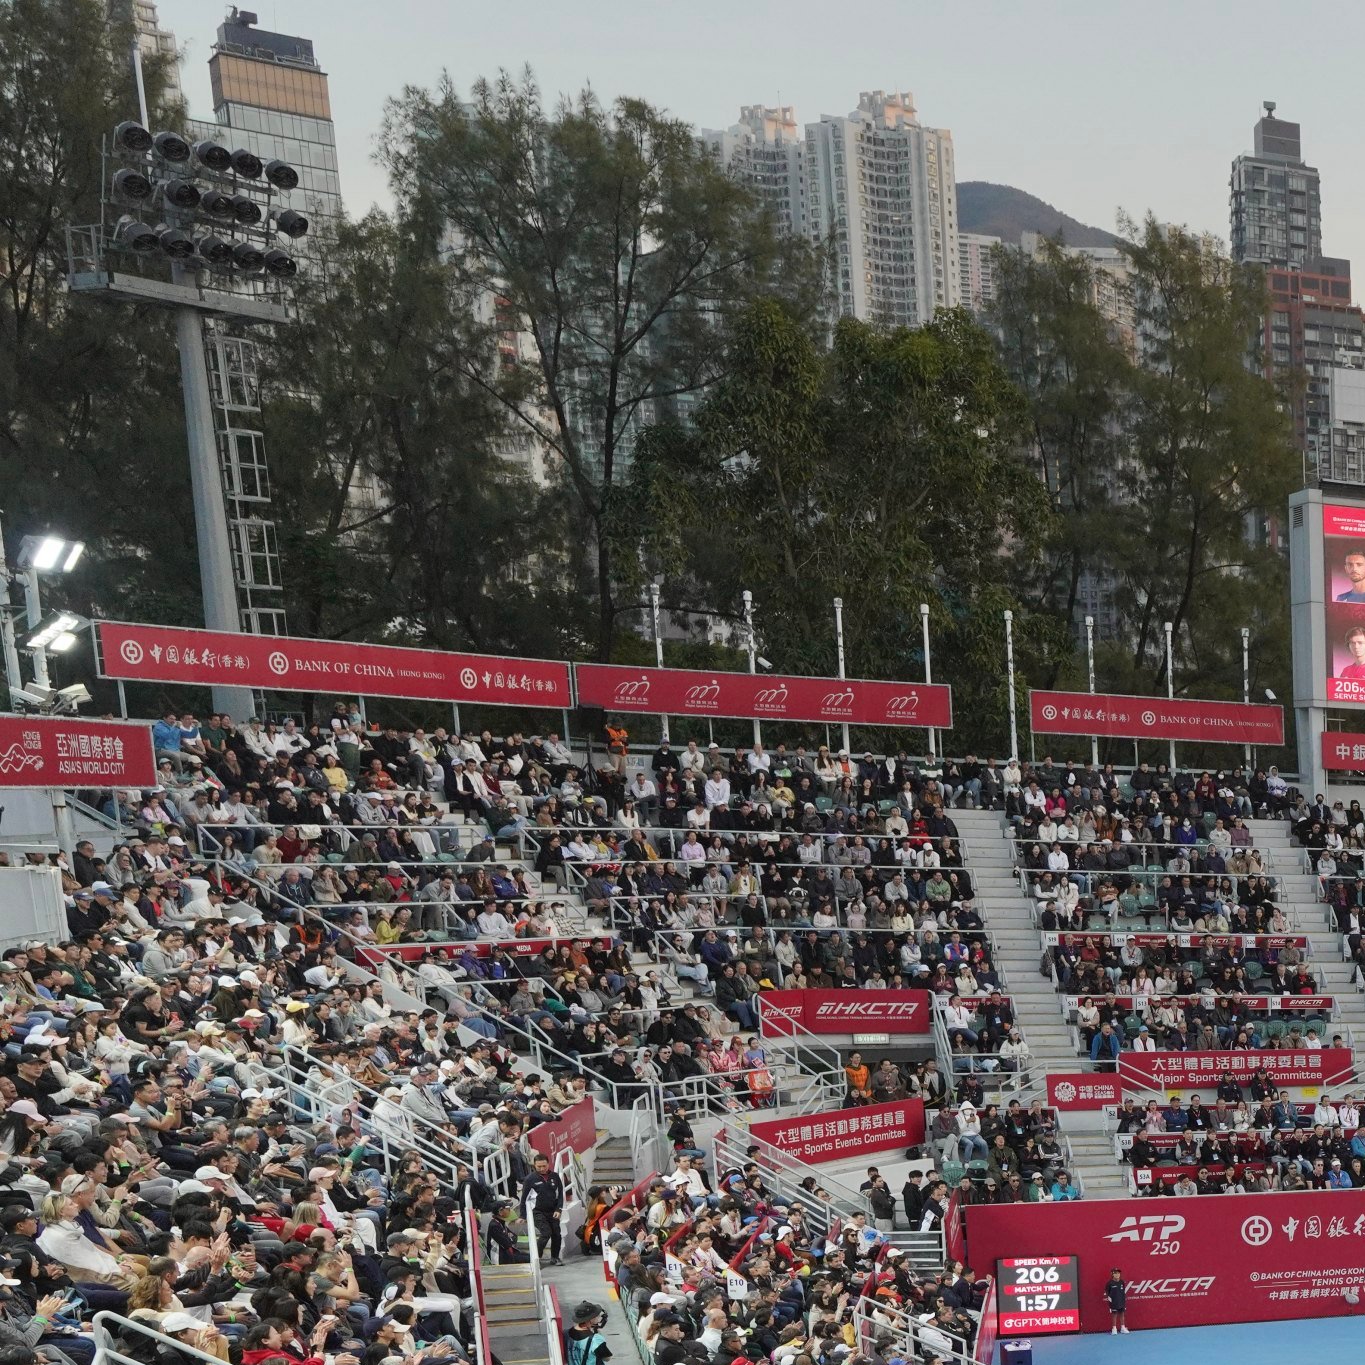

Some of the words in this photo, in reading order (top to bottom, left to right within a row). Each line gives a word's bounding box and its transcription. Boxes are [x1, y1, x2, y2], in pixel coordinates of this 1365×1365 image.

[294, 658, 331, 673] BANK
[334, 662, 351, 674] OF
[354, 664, 394, 678] CHINA
[1334, 692, 1357, 701] SERVE
[56, 733, 124, 760] 亞洲國際都會
[59, 762, 82, 775] ASIA'S
[82, 762, 107, 775] WORLD
[107, 763, 125, 776] CITY
[1151, 1055, 1322, 1071] 大型體育活動事務委員會
[774, 1109, 906, 1146] 大型體育活動事務委員會
[804, 1142, 833, 1157] Sports
[835, 1136, 862, 1150] Events
[864, 1129, 907, 1144] Committee
[1102, 1215, 1186, 1242] ATP
[1150, 1240, 1181, 1256] 250
[1014, 1258, 1038, 1266] SPEED
[1015, 1266, 1060, 1284] 206
[1260, 1272, 1283, 1280] BANK
[1284, 1271, 1296, 1279] OF
[1296, 1269, 1322, 1278] CHINA
[1322, 1268, 1348, 1277] HONG
[1311, 1277, 1343, 1286] TENNIS
[1124, 1276, 1216, 1294] HKCTA
[1016, 1294, 1060, 1311] 1:57
